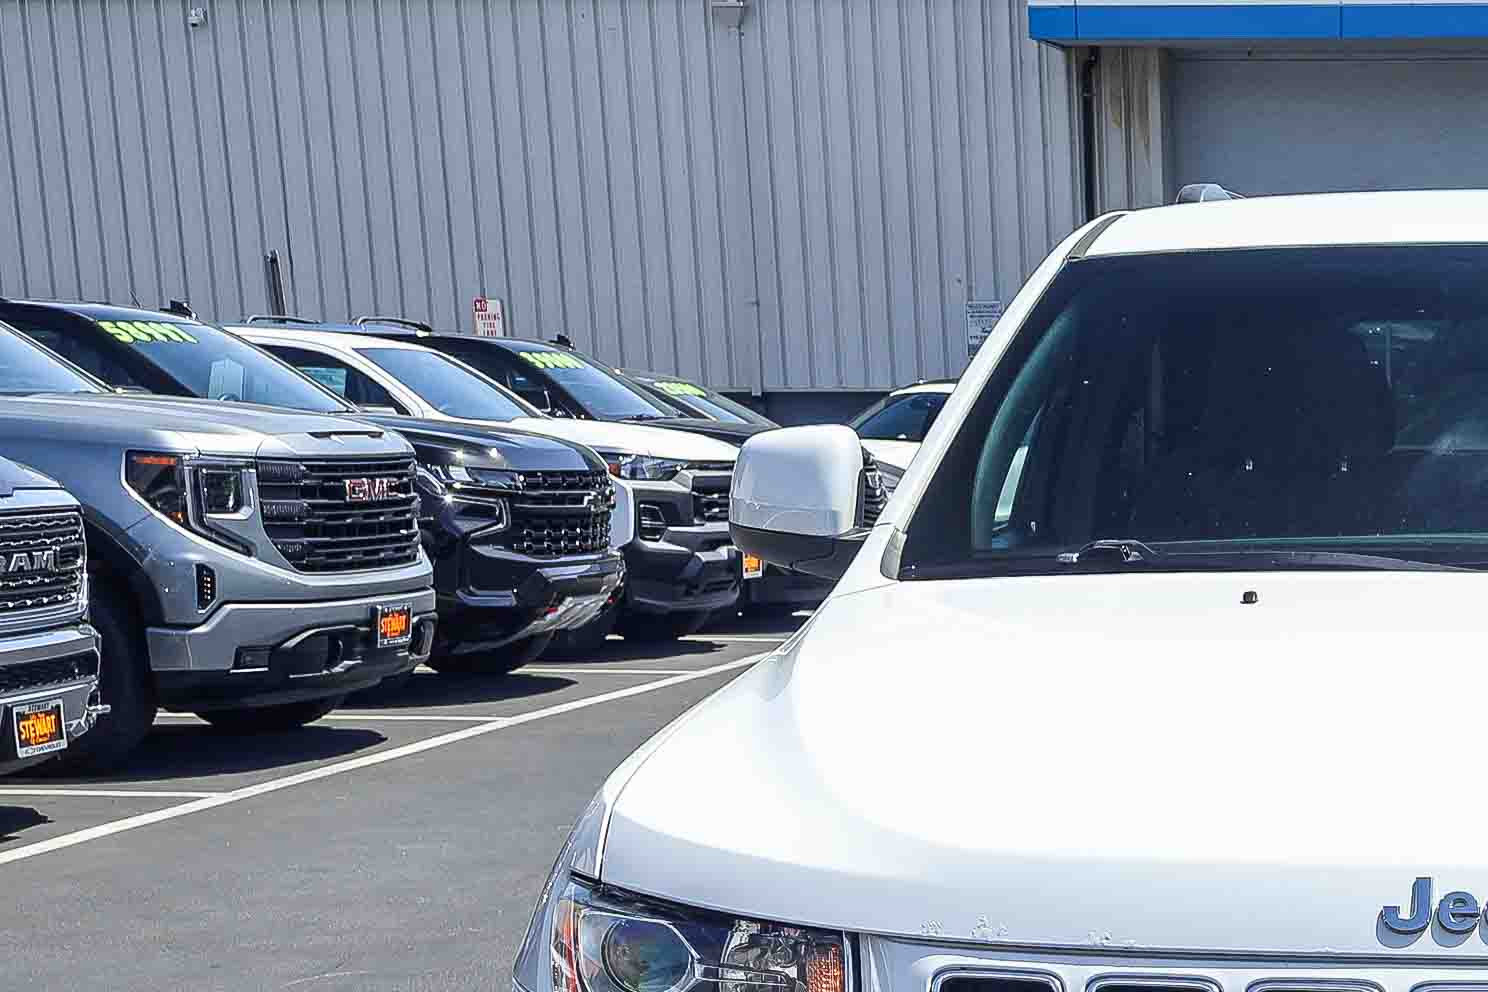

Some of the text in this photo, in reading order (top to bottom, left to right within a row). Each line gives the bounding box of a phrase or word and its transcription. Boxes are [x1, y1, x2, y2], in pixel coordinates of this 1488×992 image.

[474, 300, 487, 310] NO
[345, 478, 399, 501] GMC
[19, 714, 56, 740] STEWART
